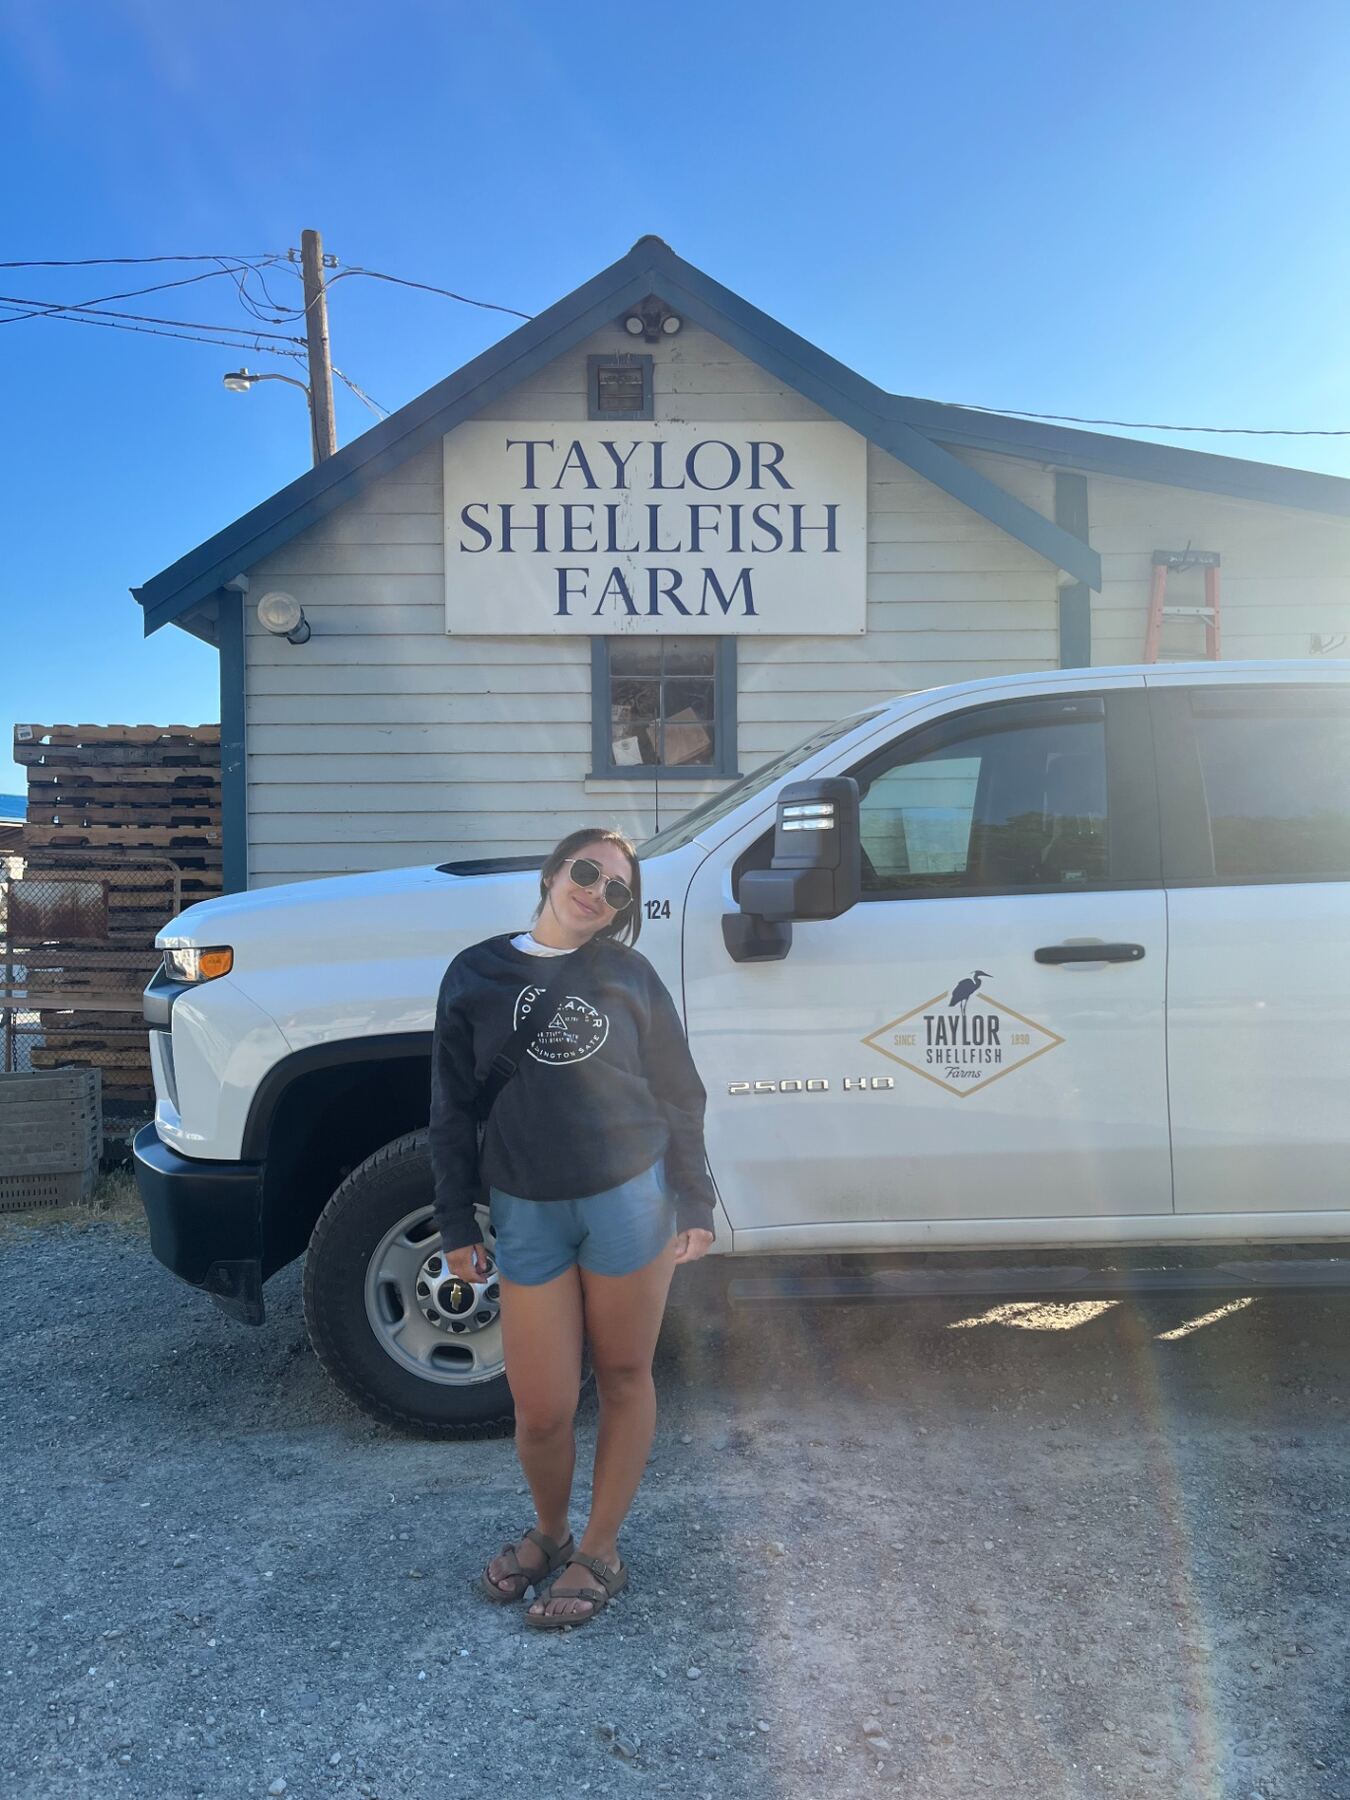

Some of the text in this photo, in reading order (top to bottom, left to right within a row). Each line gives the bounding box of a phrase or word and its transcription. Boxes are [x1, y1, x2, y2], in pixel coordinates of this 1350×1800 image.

[505, 439, 796, 491] TAYLOR
[459, 502, 841, 553] SHELLFISH
[552, 566, 760, 616] FARM
[644, 899, 671, 920] 124
[893, 1034, 917, 1046] SINCE
[923, 1015, 1001, 1046] TAYLOR
[926, 1048, 1002, 1064] SHELLFISH
[944, 1066, 982, 1079] Farms
[727, 1075, 894, 1096] 2500 HD
